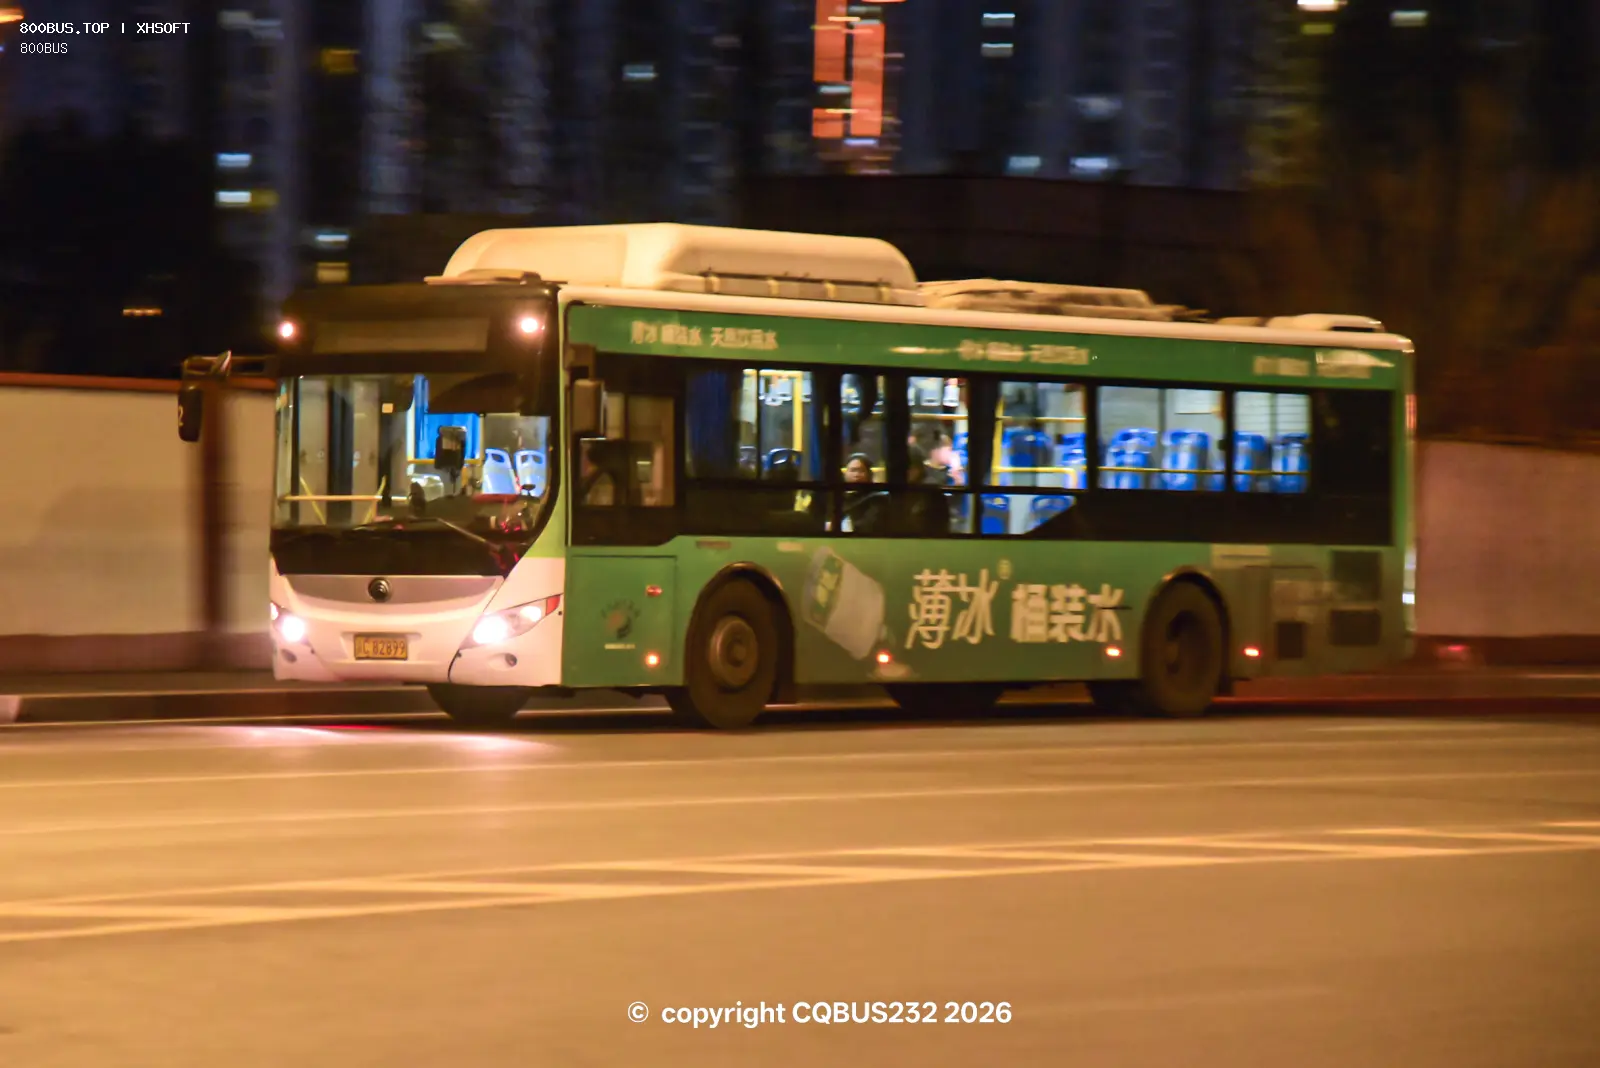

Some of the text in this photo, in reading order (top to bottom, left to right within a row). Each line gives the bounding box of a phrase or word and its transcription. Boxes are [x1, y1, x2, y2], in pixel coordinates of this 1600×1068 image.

[905, 568, 1124, 649] 薄冰 桶装水
